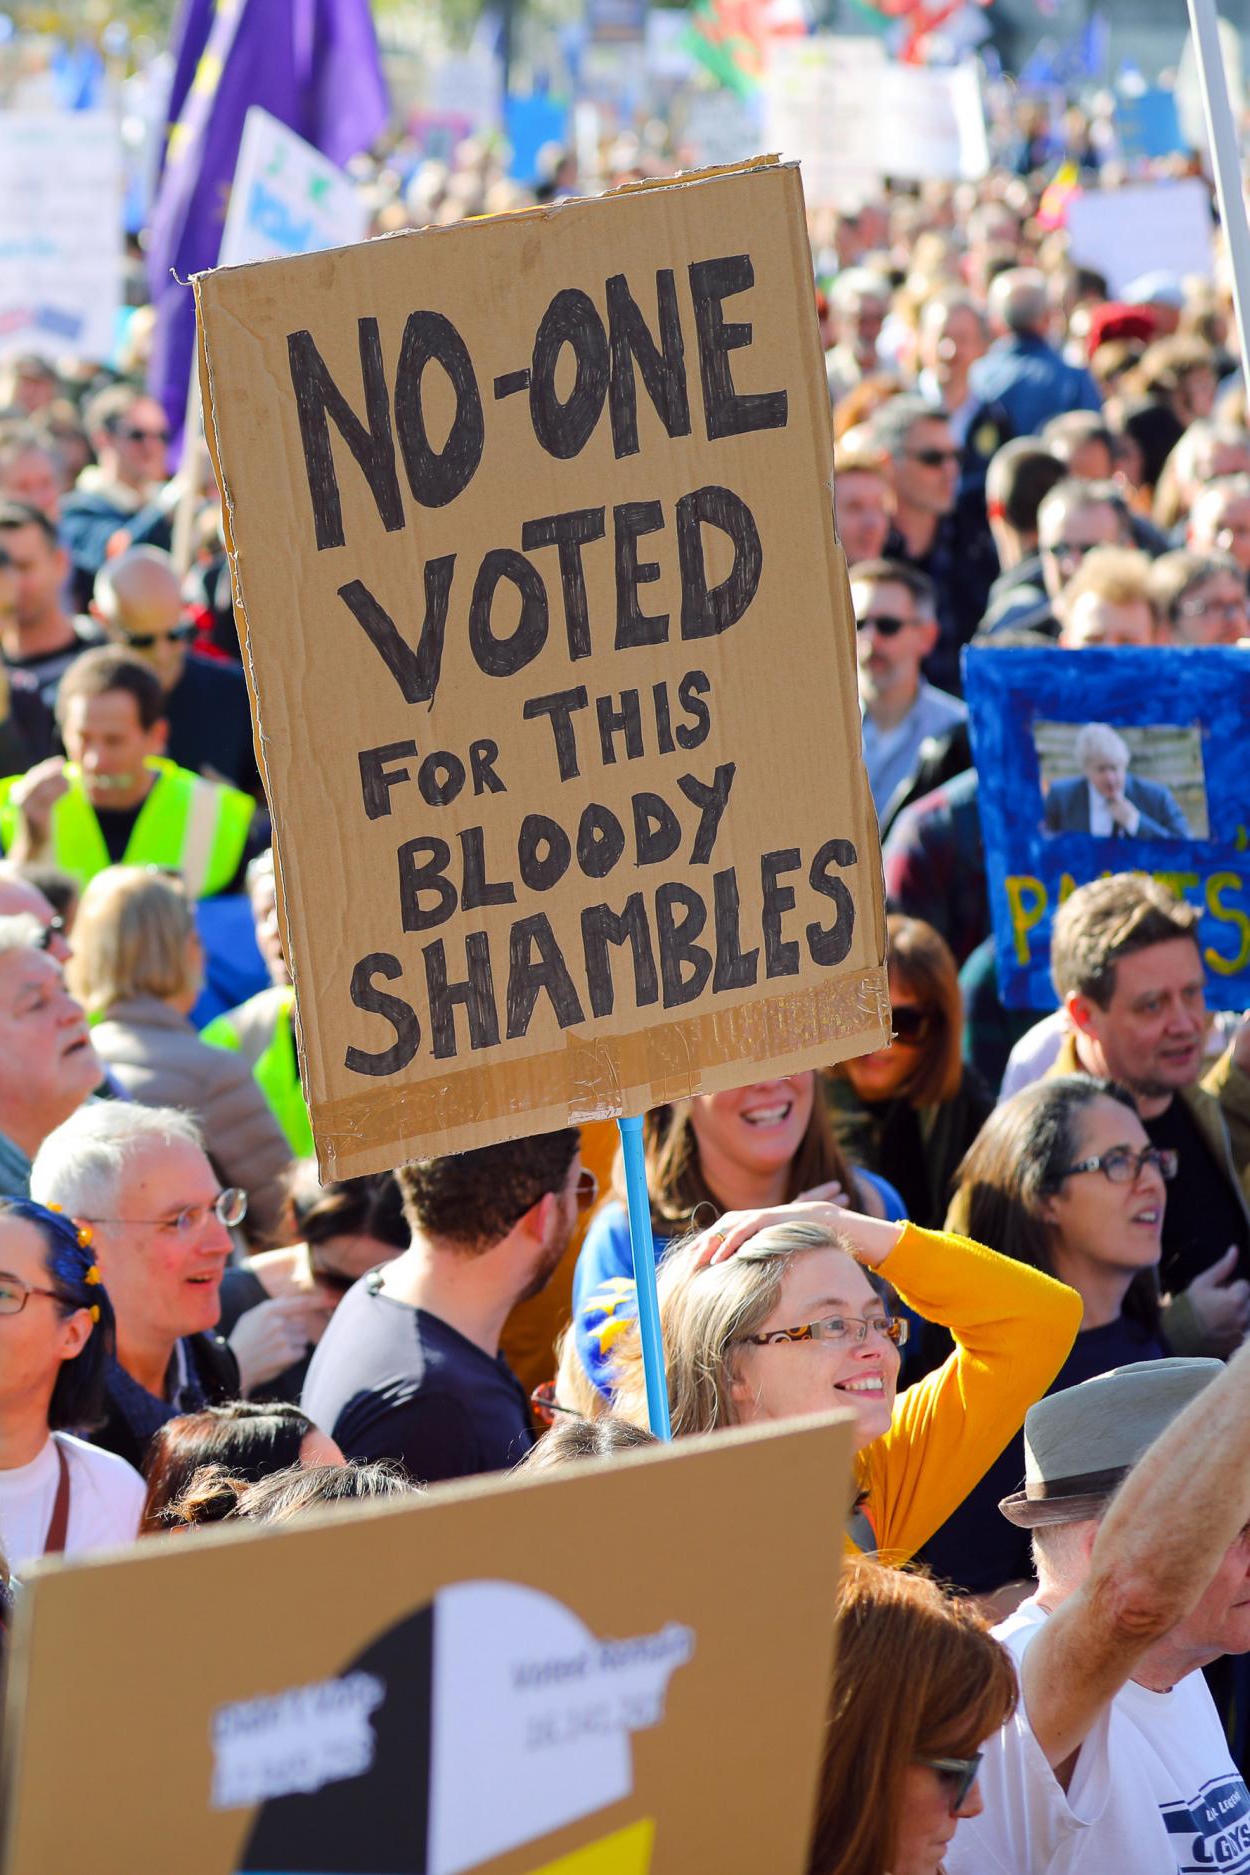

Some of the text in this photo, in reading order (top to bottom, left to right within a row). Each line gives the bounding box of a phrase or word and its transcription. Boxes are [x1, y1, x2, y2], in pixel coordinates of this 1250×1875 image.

[286, 254, 788, 551] NO-ONE
[337, 486, 762, 712] VOTED
[358, 671, 710, 820] FOR THIS
[397, 762, 736, 933] BLOODY
[344, 839, 857, 1076] SHAMBLES
